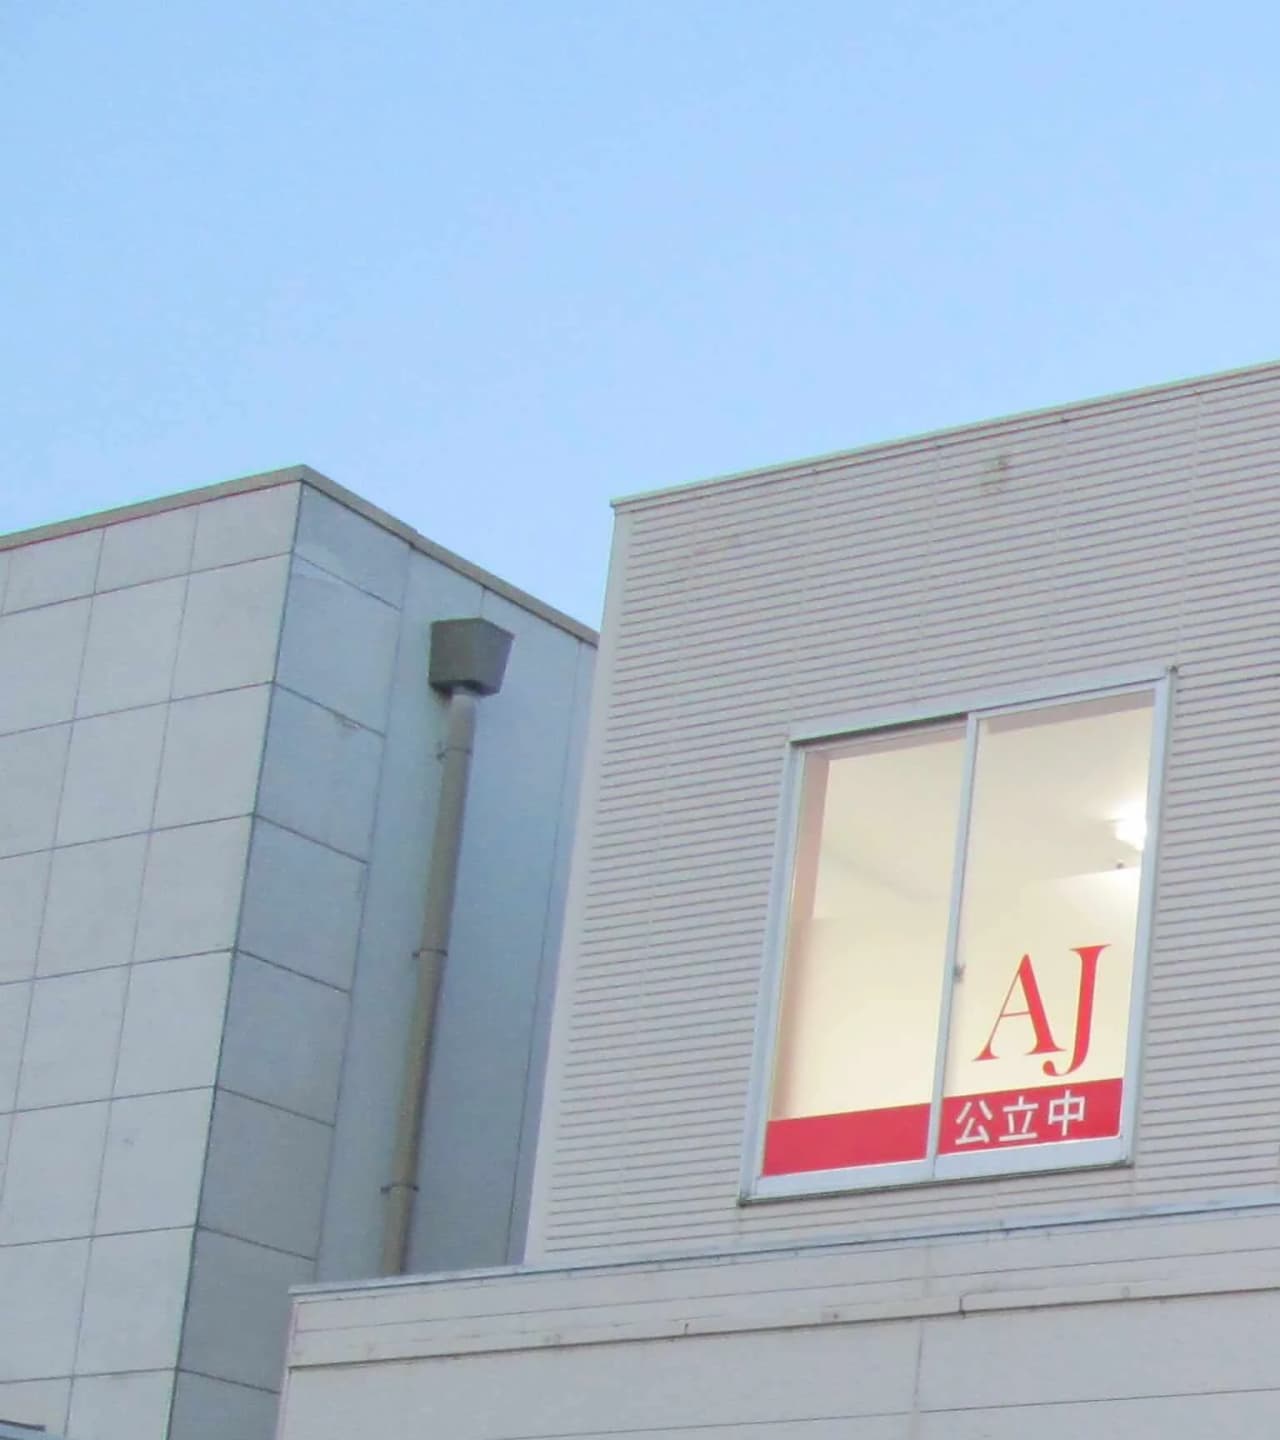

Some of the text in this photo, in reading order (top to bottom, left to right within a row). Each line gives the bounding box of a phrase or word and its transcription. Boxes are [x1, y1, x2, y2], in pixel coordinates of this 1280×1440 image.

[972, 943, 1111, 1077] AJ
[954, 1089, 1085, 1147] 公立中
